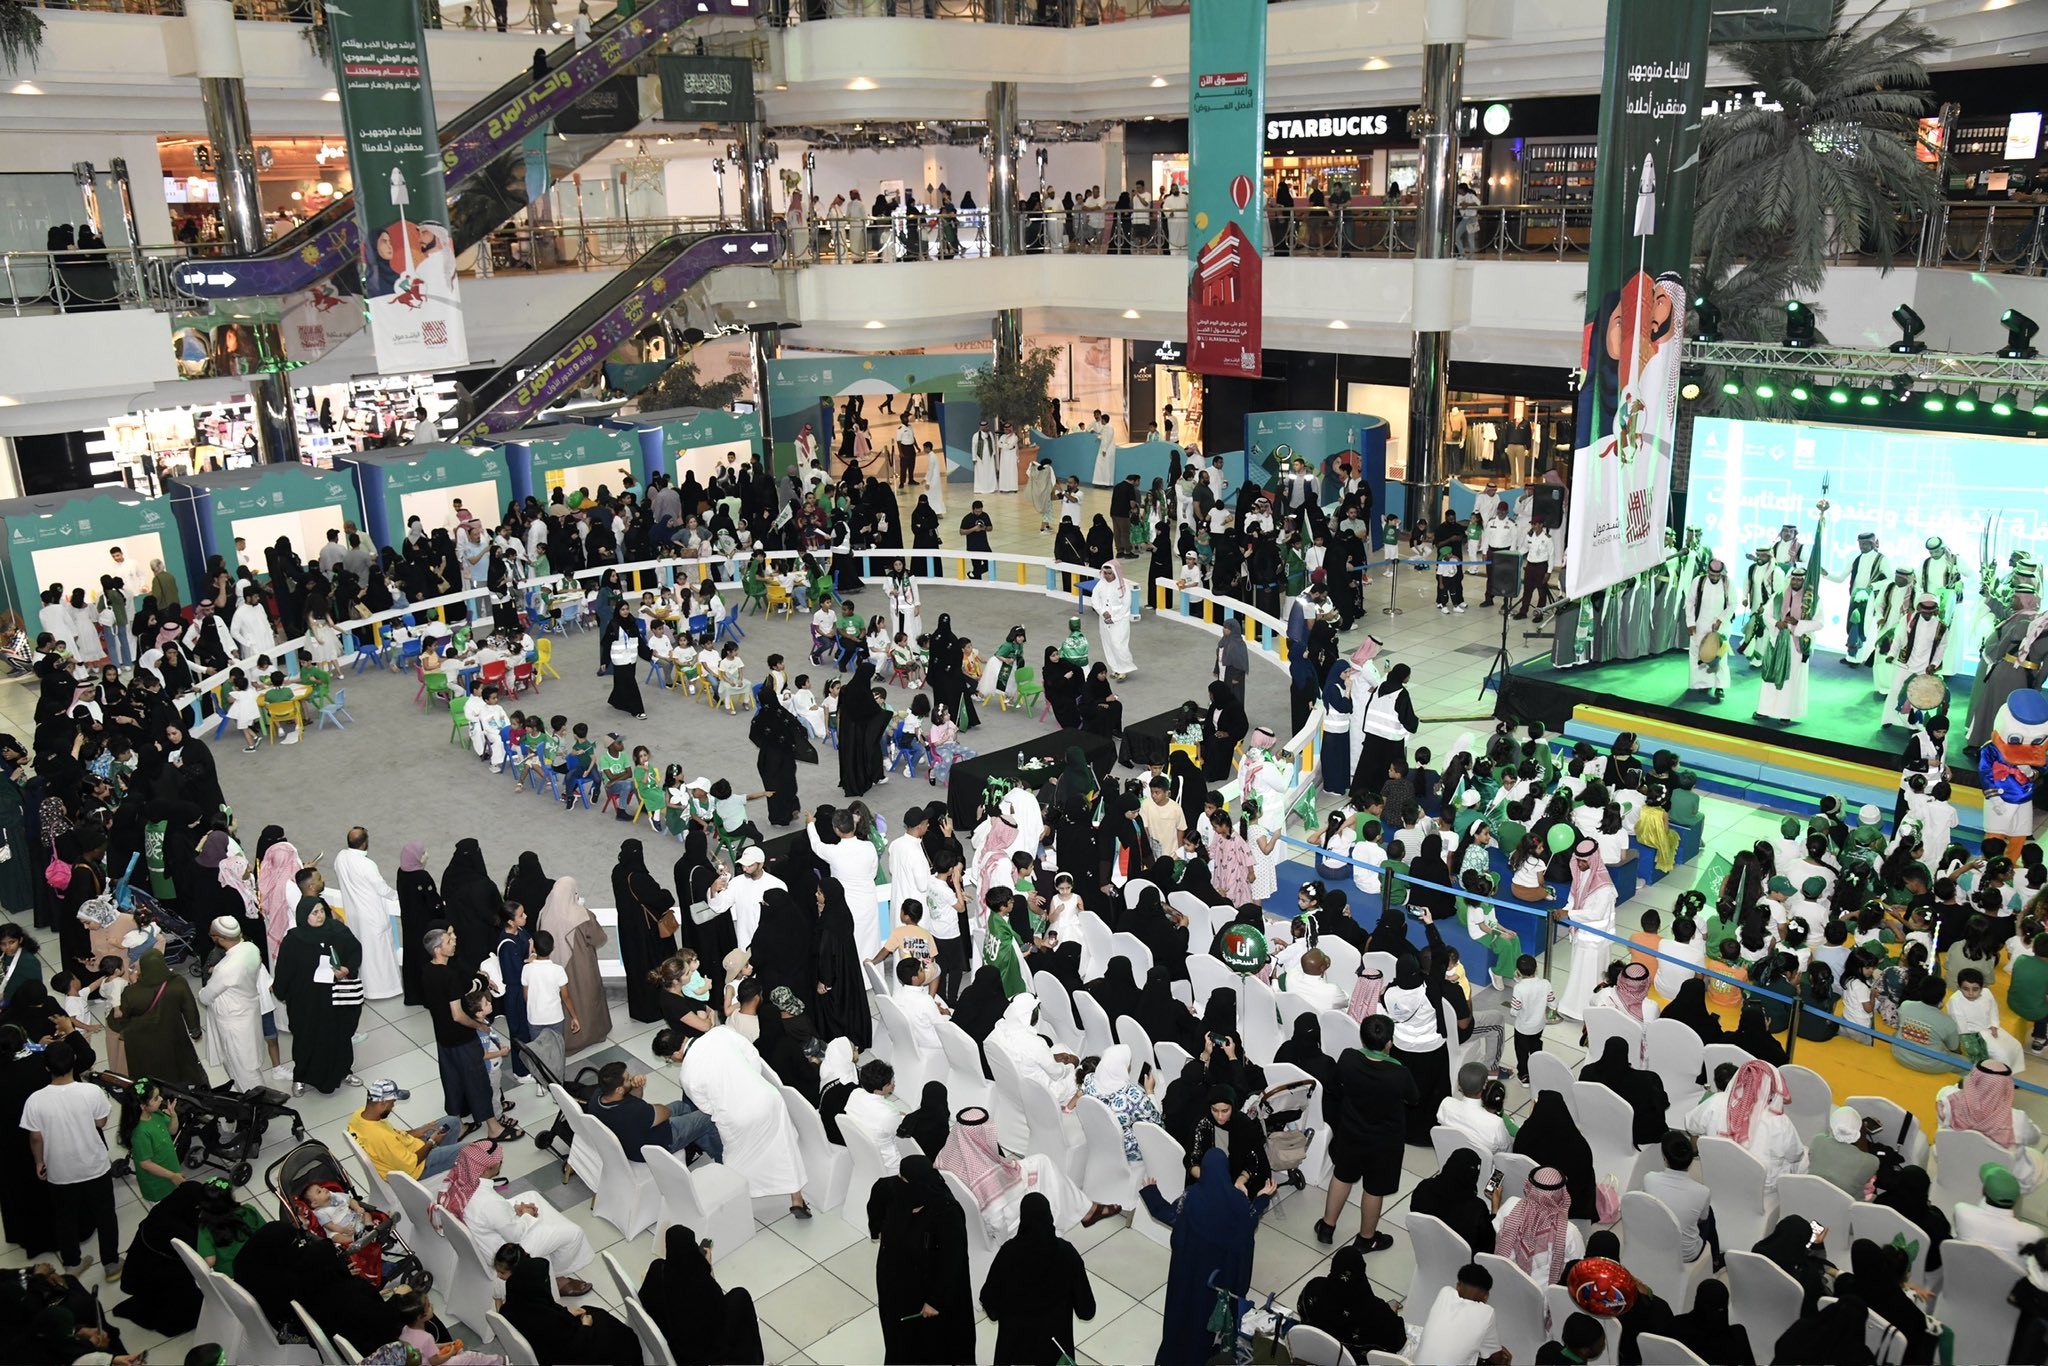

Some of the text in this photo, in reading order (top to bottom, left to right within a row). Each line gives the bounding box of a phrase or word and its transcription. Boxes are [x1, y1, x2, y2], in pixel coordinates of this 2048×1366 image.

[376, 54, 400, 64] الوطني
[1214, 73, 1248, 86] تسوق
[487, 97, 527, 139] المرح
[360, 127, 422, 138] للعلياء متوجهين
[1267, 115, 1388, 140] STARBUCKS
[393, 143, 424, 153] محققين
[517, 367, 554, 406] المرح
